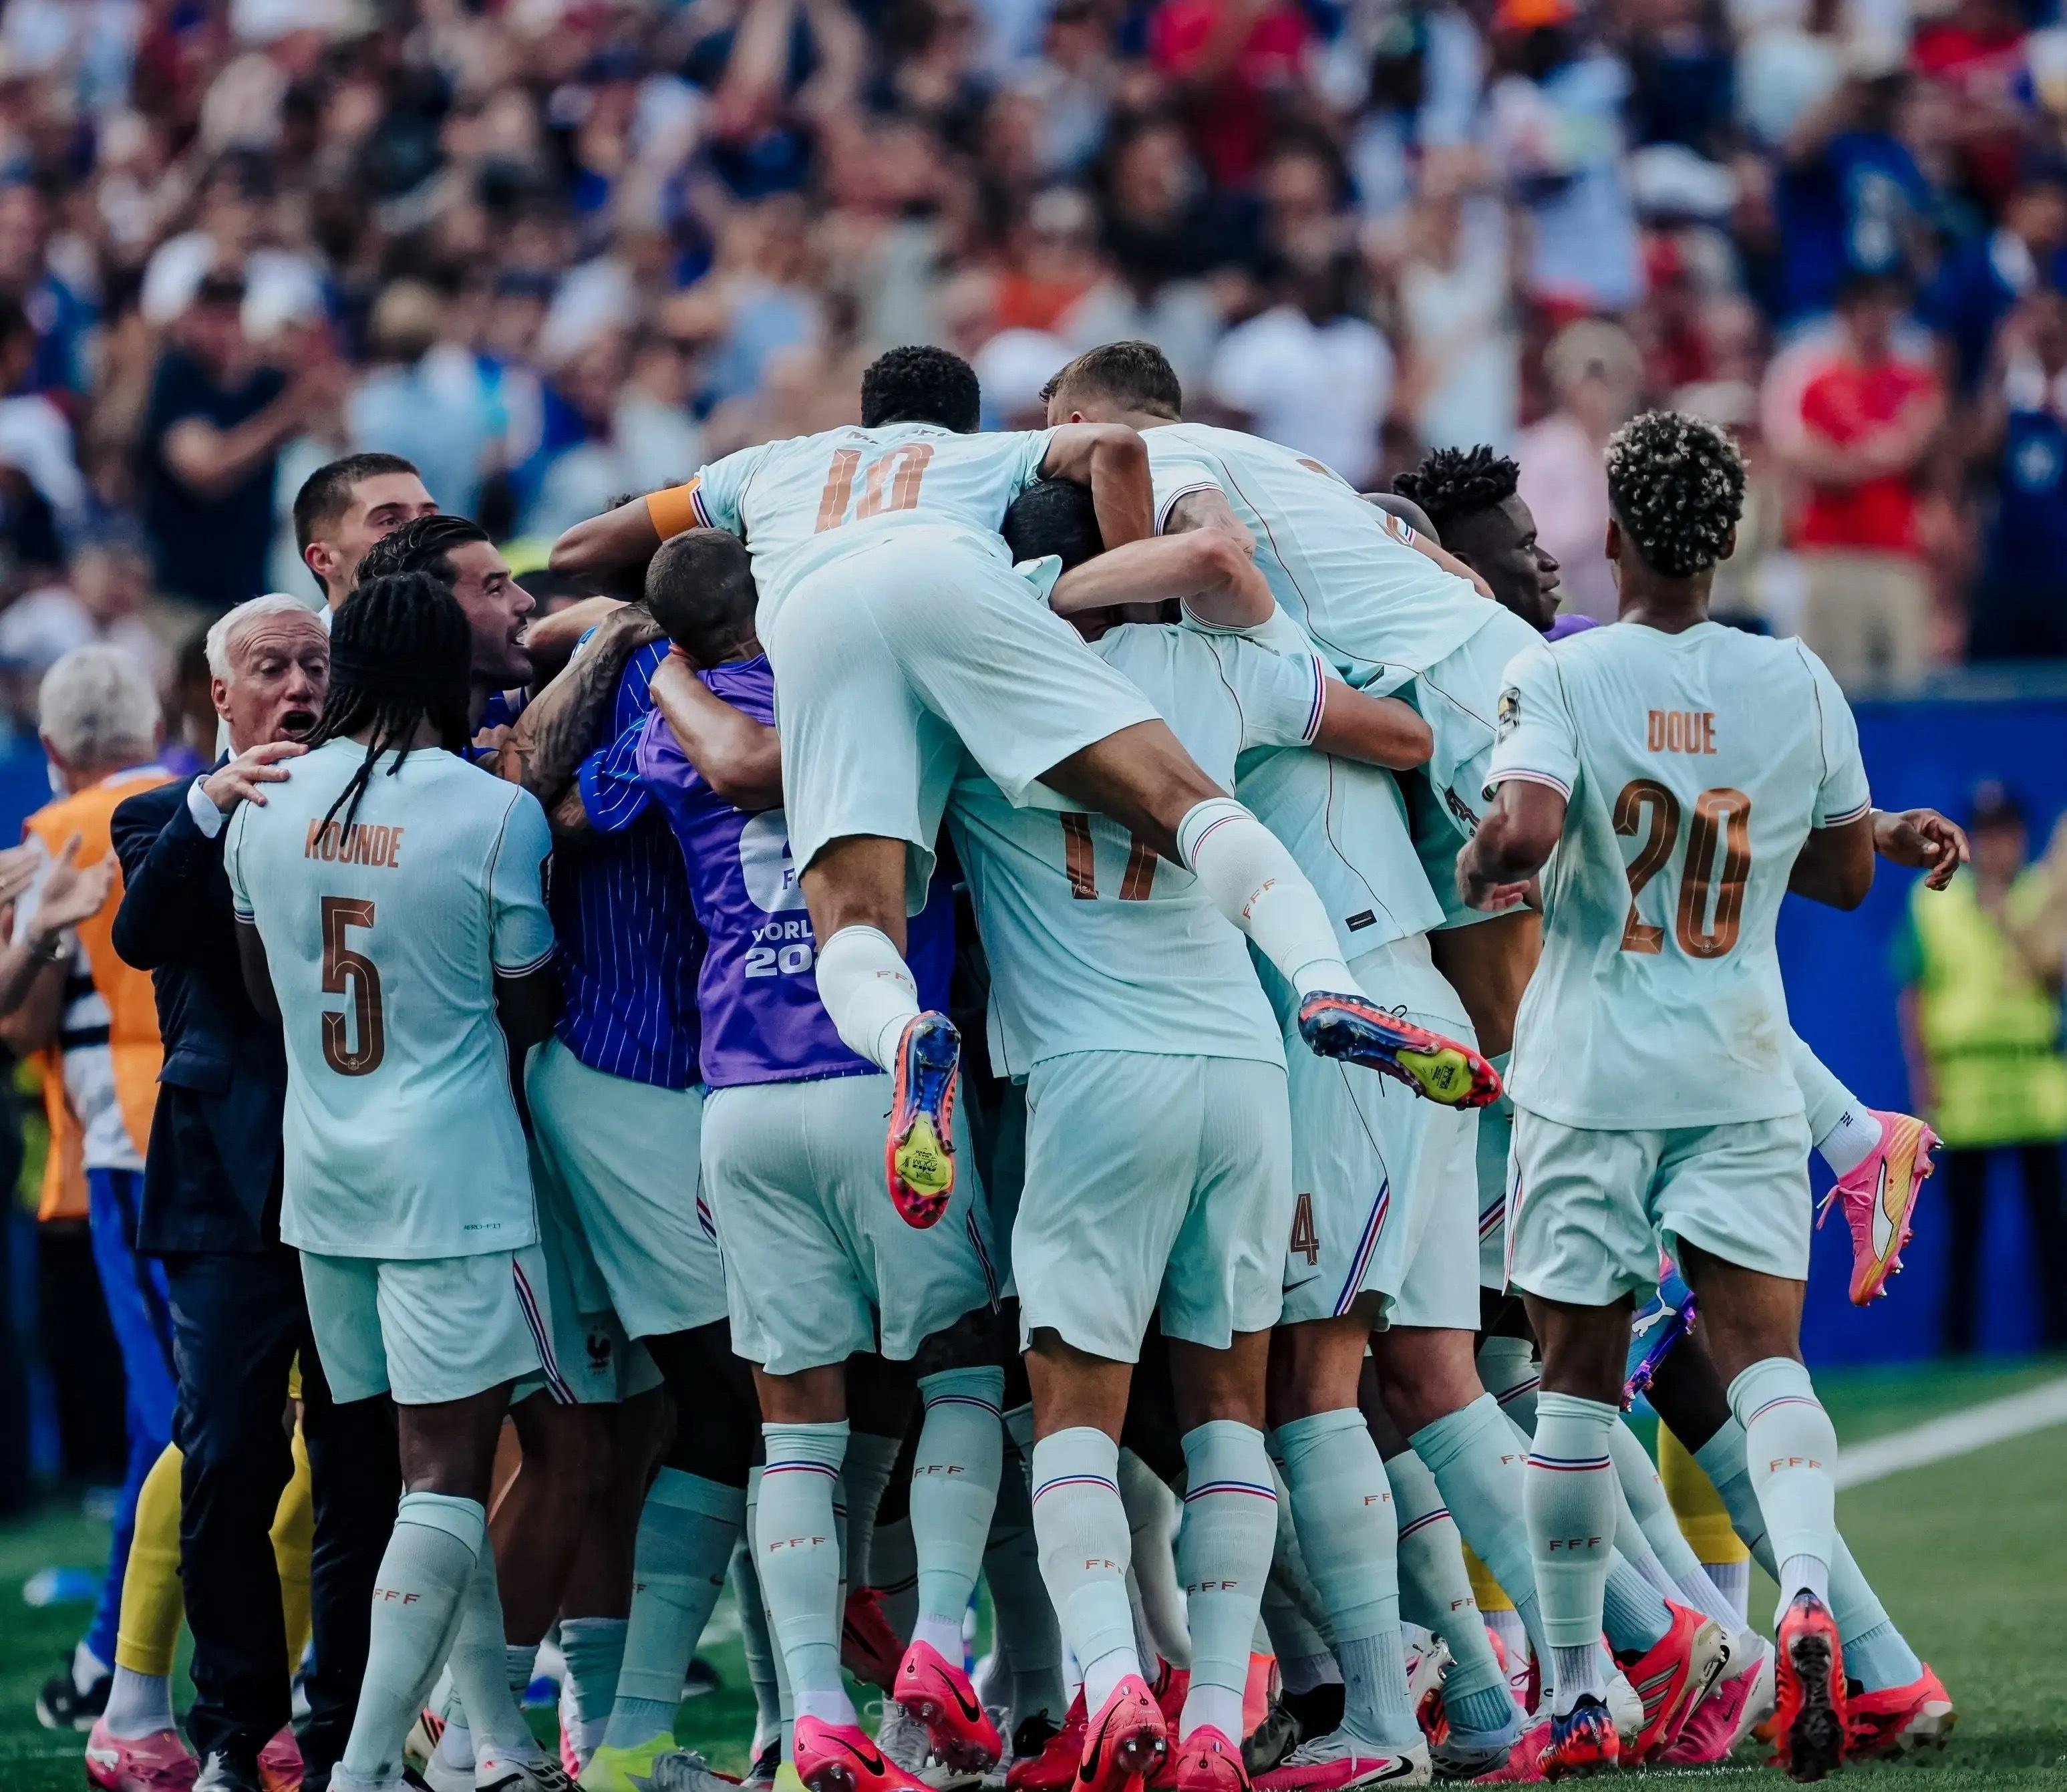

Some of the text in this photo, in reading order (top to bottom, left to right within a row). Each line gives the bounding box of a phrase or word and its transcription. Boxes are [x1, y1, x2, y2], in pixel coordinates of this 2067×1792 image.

[814, 442, 935, 534] 10
[1648, 710, 1717, 754] DOUE
[305, 818, 404, 868] KOUNDE
[1612, 778, 1751, 959] 20
[752, 919, 814, 942] ORL
[745, 943, 818, 978] 20
[321, 896, 384, 1076] 5
[1290, 1193, 1320, 1266] 4
[915, 1465, 965, 1479] FFF
[1770, 1457, 1822, 1471] FFF
[770, 1537, 826, 1552] FFF
[1549, 1537, 1602, 1551] FFF
[373, 1588, 422, 1604] FFF
[1186, 1580, 1237, 1596] FFF
